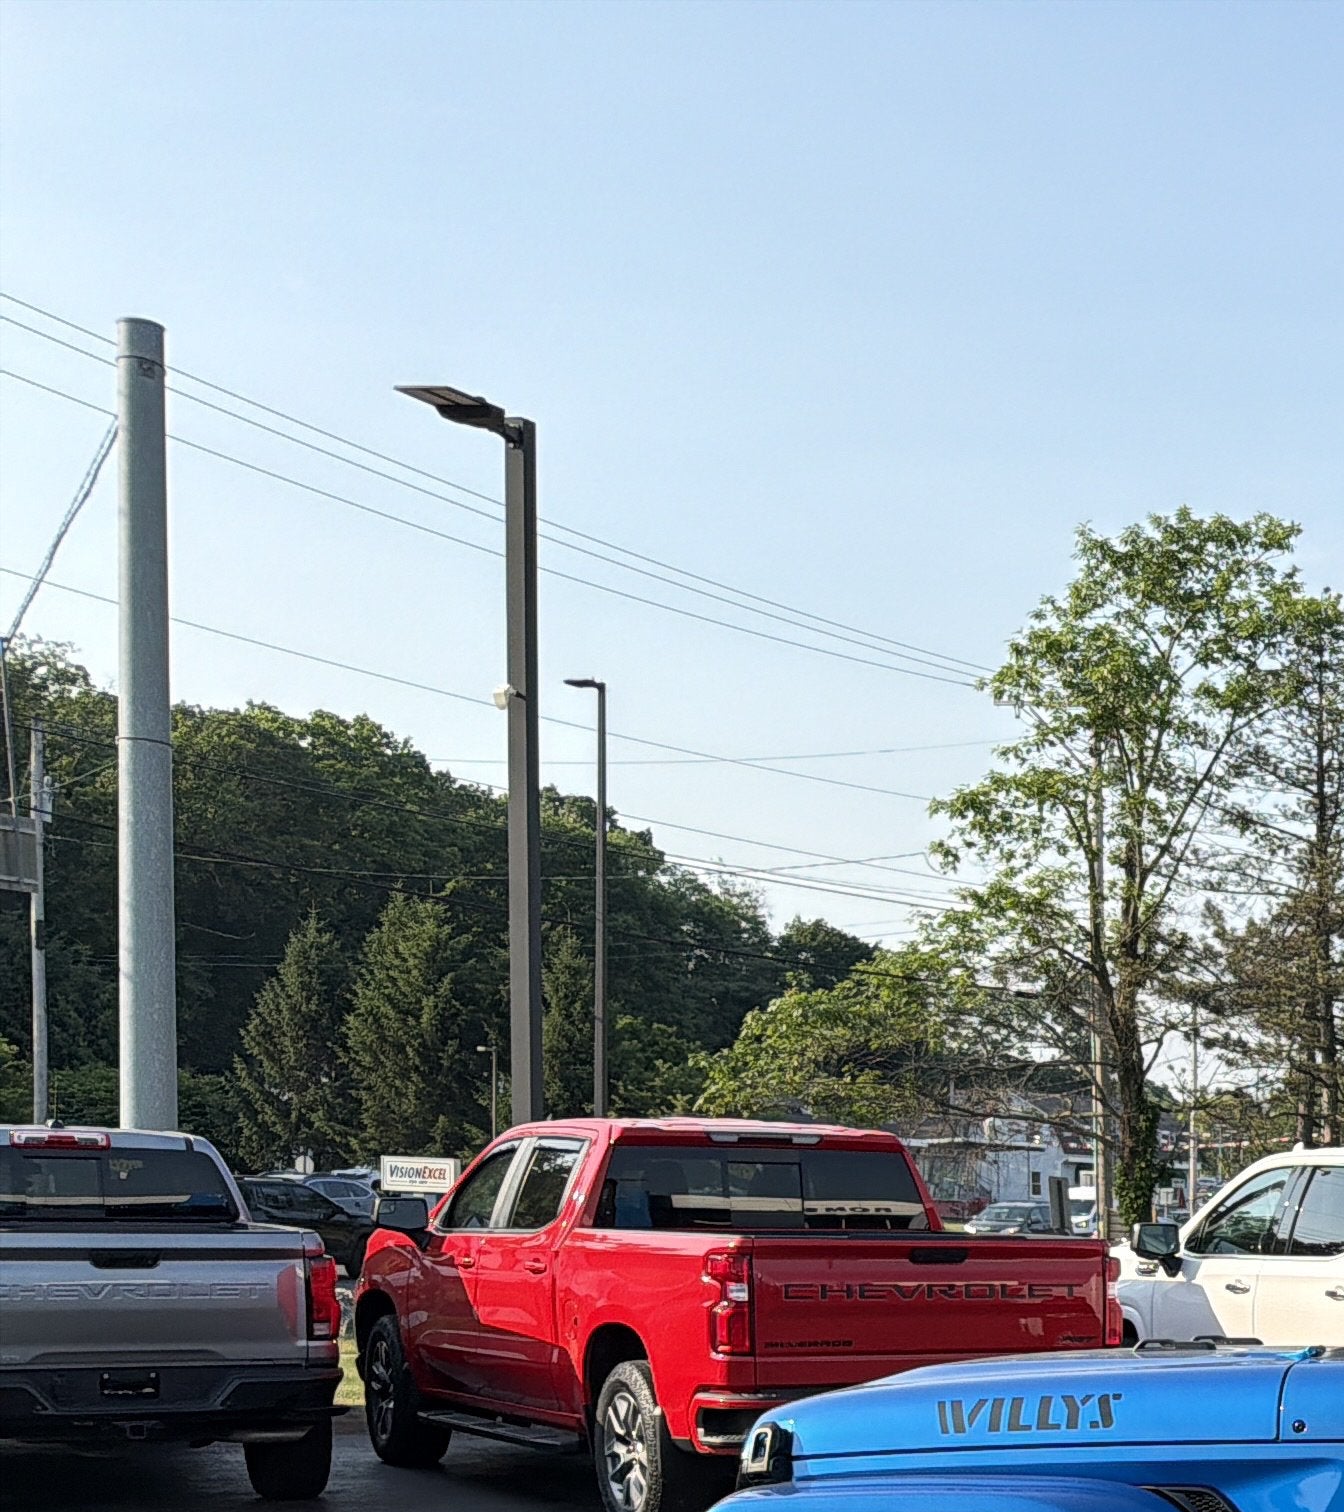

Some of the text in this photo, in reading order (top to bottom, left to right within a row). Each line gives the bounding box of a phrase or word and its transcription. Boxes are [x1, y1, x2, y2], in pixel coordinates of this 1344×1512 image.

[0, 1283, 269, 1300] HEVROLET
[783, 1283, 1083, 1300] CHEVROLET
[938, 1393, 1122, 1434] WILLYS
